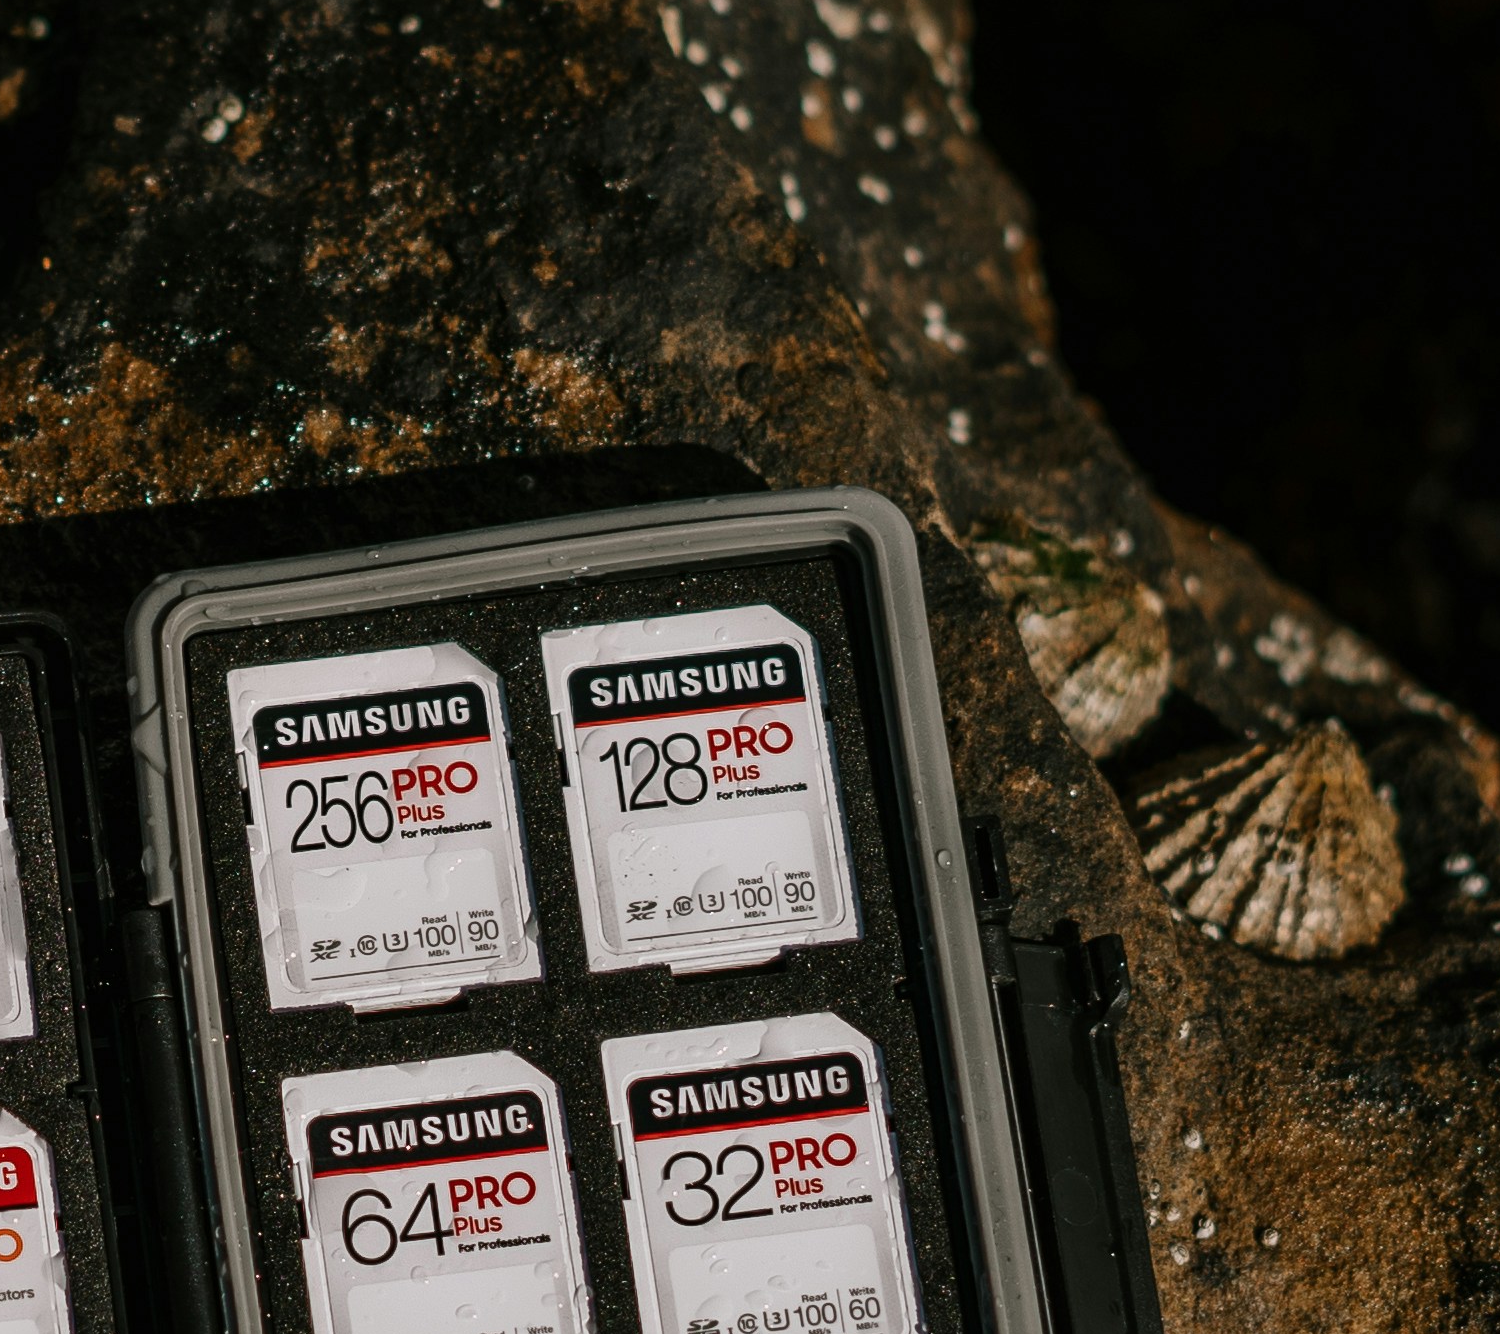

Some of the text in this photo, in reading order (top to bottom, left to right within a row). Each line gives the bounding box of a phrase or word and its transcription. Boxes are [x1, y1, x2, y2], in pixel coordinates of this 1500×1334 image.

[590, 657, 786, 707] SAMSUNG
[275, 696, 470, 746] SAMSUNG
[599, 721, 793, 812] 128 PRO
[712, 764, 760, 784] Plus
[716, 782, 807, 801] For Professionals
[286, 761, 478, 853] 256 PRO
[397, 804, 445, 824] Plus
[401, 820, 492, 839] For Professionals
[738, 871, 810, 886] Read Write
[730, 885, 772, 910] 100
[783, 880, 815, 904] 90
[422, 909, 494, 925] Read Write
[413, 924, 456, 948] 100
[467, 919, 499, 942] 90
[650, 1066, 849, 1118] SAMSUNG
[330, 1104, 528, 1156] SAMSUNG
[663, 1133, 857, 1226] 32 PRO
[775, 1177, 824, 1198] Plus
[780, 1195, 873, 1214] For Professionals
[341, 1171, 537, 1266] 64 PRO
[454, 1215, 503, 1236] Plus
[458, 1233, 551, 1253] For Professionals
[802, 1286, 876, 1303] Read Write
[794, 1303, 837, 1327] 100
[849, 1296, 881, 1321] 60
[527, 1325, 553, 1334] Write
